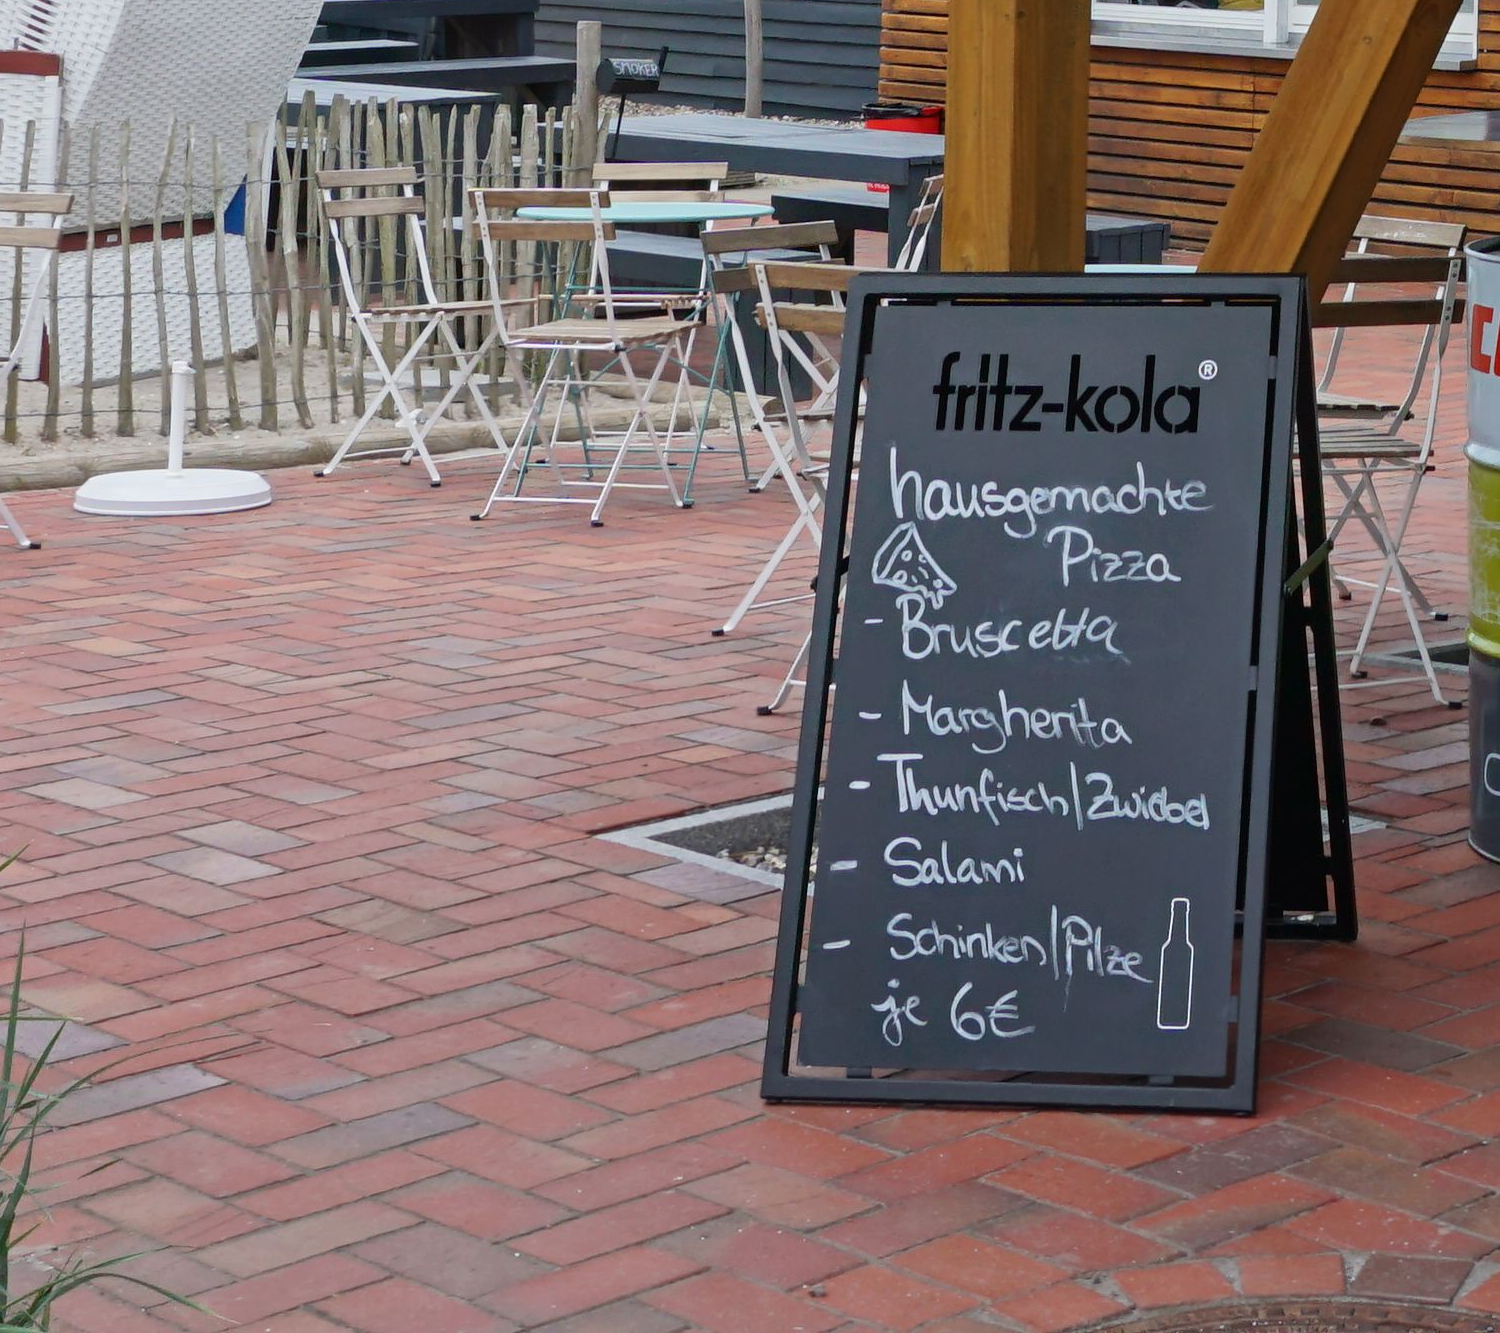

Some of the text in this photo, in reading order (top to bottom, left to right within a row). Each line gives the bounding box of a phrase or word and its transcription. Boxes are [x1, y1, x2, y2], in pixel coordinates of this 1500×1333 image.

[613, 61, 659, 77] SMOKER
[890, 442, 1214, 539] hausgemachte
[1046, 525, 1181, 586] Pizza
[901, 680, 1133, 755] Margherita
[884, 836, 1026, 887] Salami
[871, 979, 927, 1047] je
